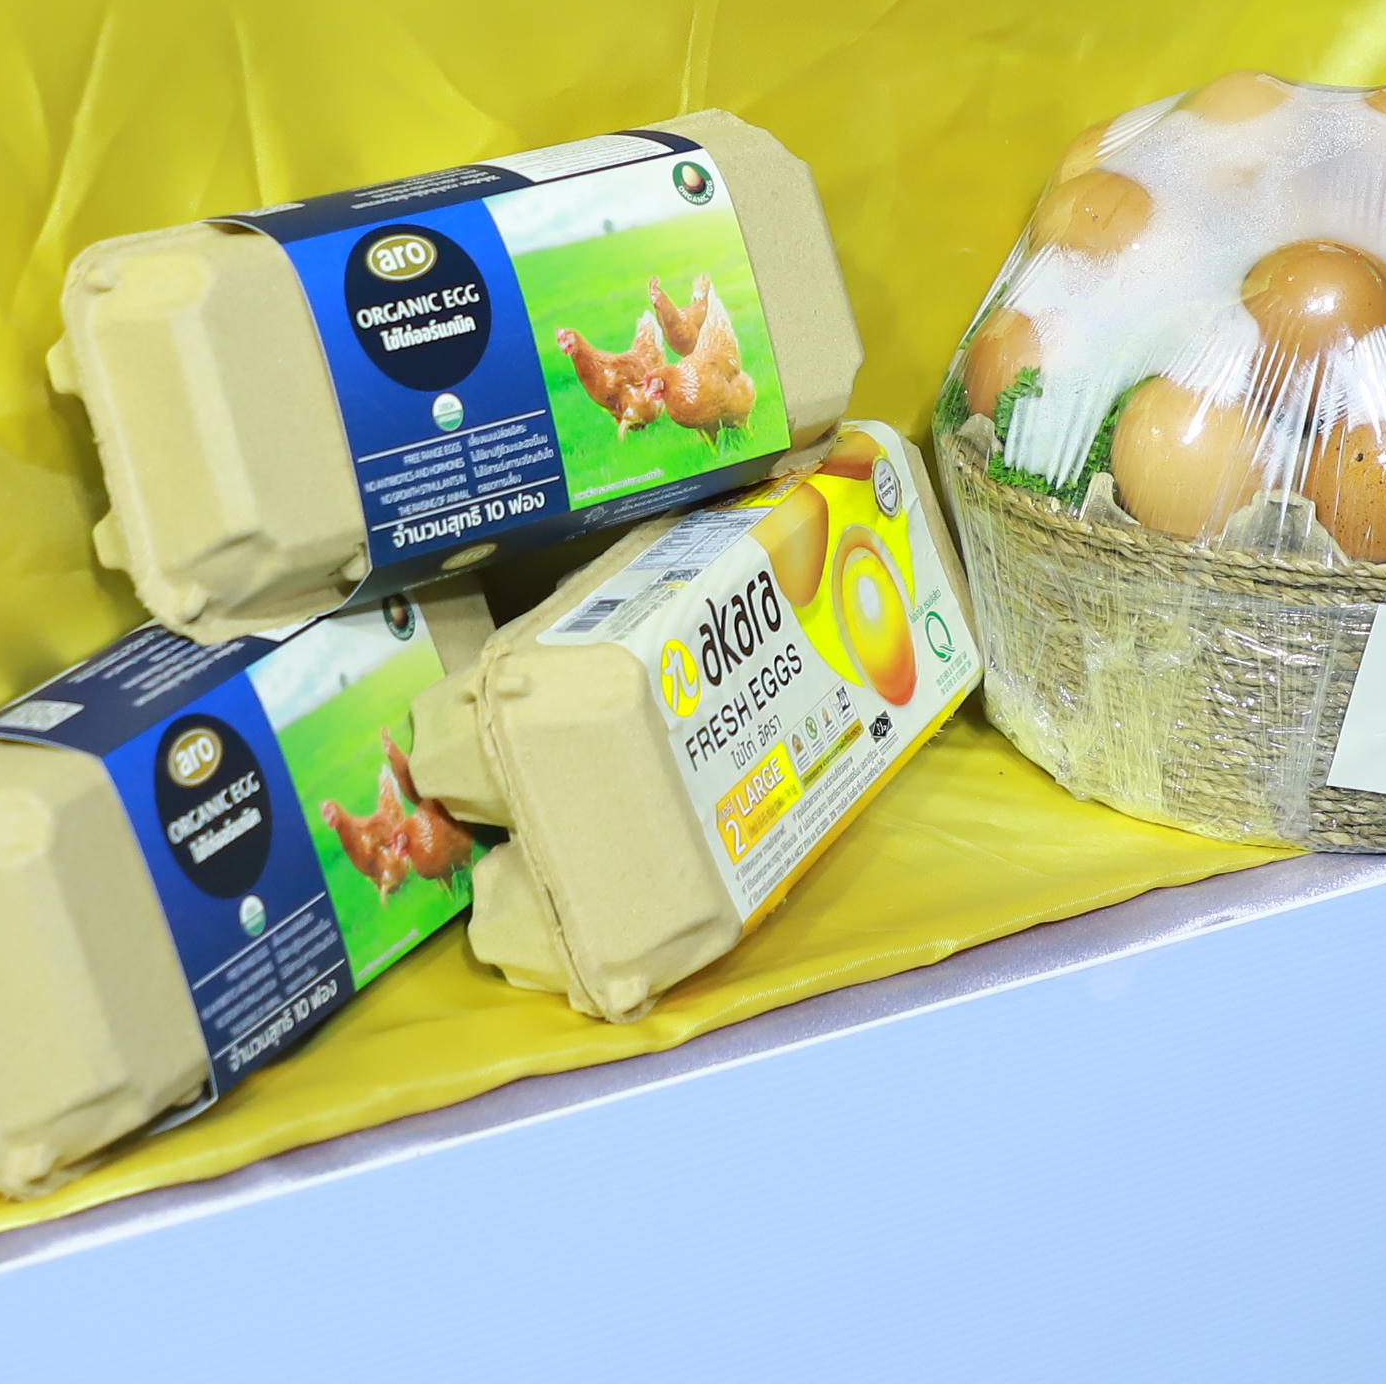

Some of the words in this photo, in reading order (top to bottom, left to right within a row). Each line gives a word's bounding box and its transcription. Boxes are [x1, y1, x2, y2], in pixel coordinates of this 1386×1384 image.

[678, 185, 710, 204] ORGANIC
[376, 241, 427, 273] aro
[355, 292, 443, 330] ORGANIC
[441, 283, 481, 310] EGG
[379, 315, 477, 352] ไข่ไก่ออร์แกนิค
[392, 506, 483, 549] จำนวนสุทธิ
[484, 499, 505, 524] 10
[507, 490, 546, 517] ฟอง
[699, 569, 782, 687] akara
[924, 610, 957, 663] Q
[685, 690, 753, 773] FRESH
[747, 643, 803, 712] EGGS
[175, 735, 216, 778] aro
[730, 732, 758, 771] ไข่ไก่
[757, 714, 784, 748] อัครา
[166, 787, 234, 845] ORGANIC
[228, 770, 262, 806] EGG
[734, 757, 785, 818] LARGE
[724, 819, 748, 857] 2
[292, 996, 311, 1024] 10
[310, 978, 339, 1011] ฟอง
